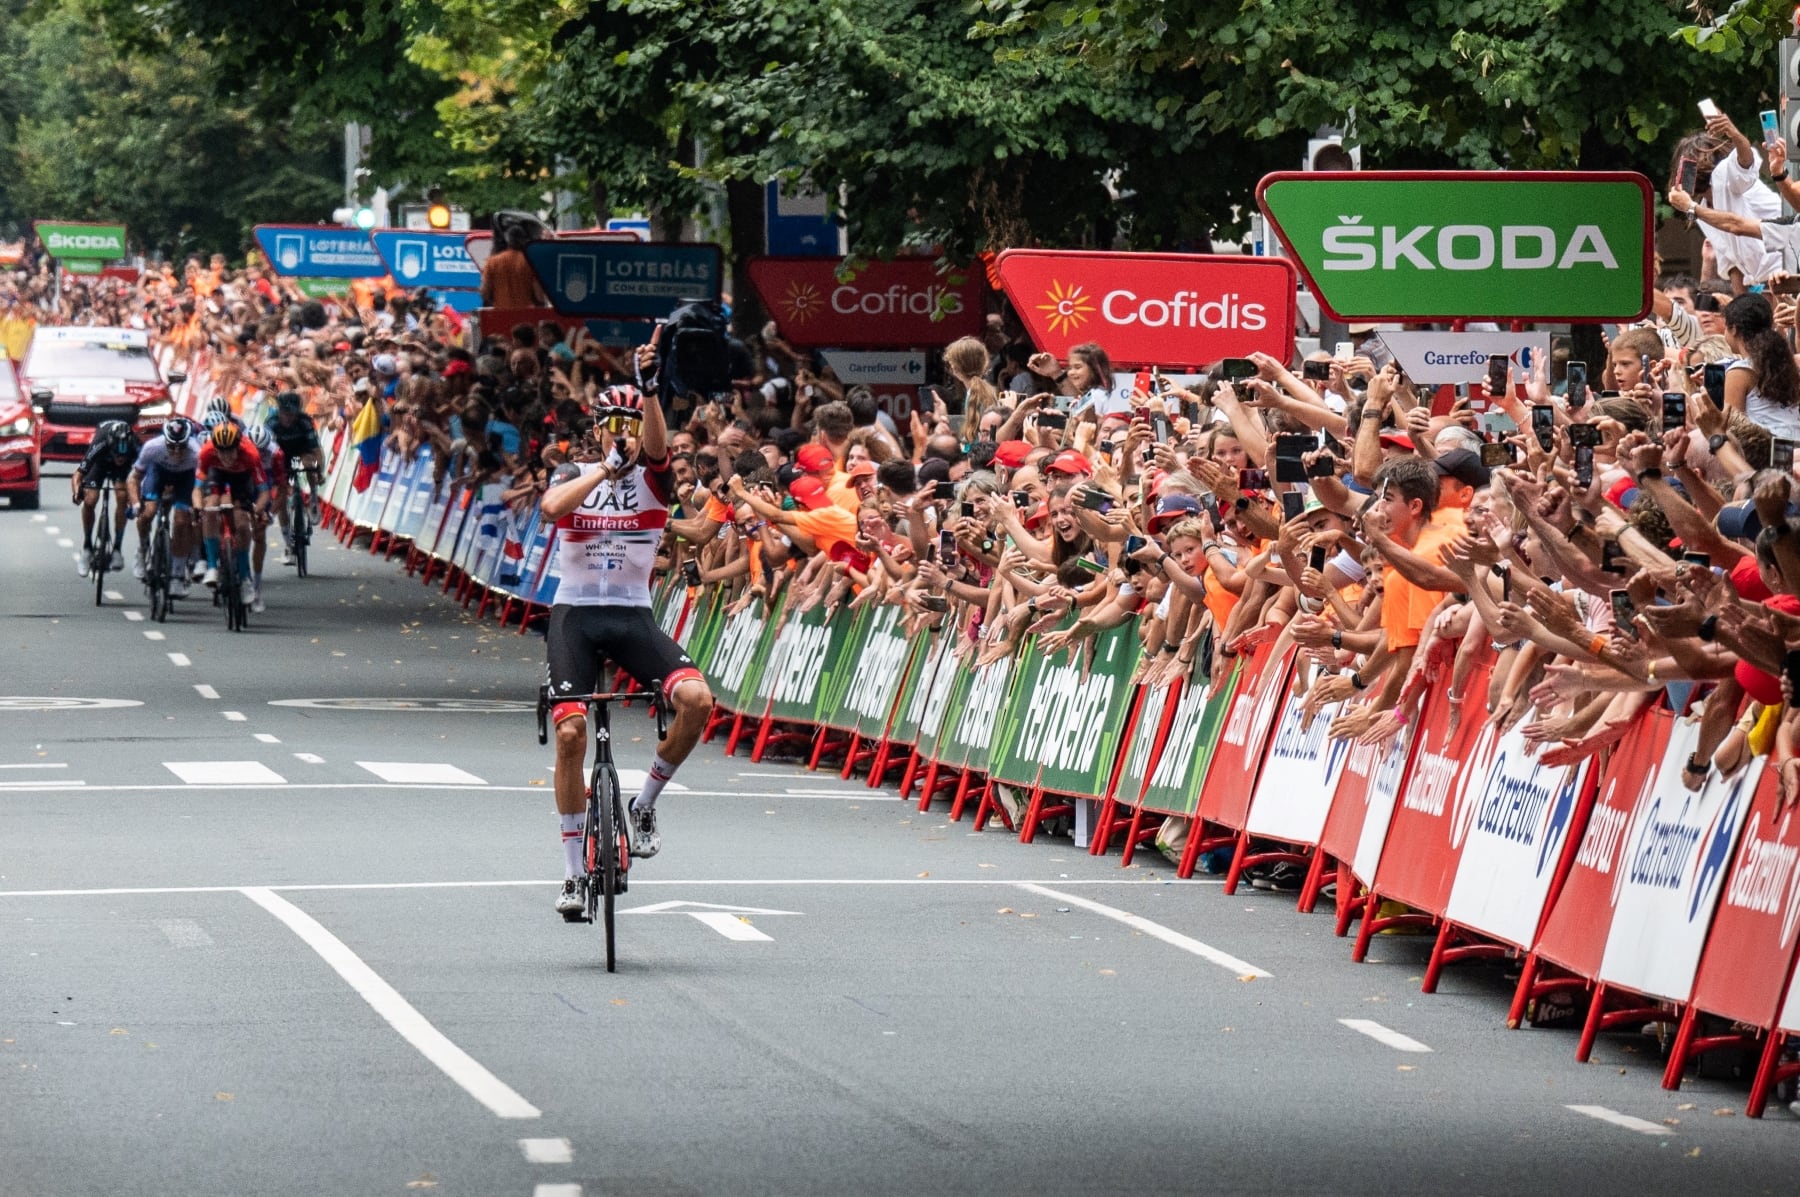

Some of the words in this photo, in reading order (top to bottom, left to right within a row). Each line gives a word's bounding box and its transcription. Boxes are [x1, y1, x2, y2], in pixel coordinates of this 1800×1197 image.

[48, 233, 120, 249] ŠKODA
[309, 237, 374, 255] LOTERÍA
[1322, 216, 1619, 270] ŠKODA
[606, 259, 709, 280] LOTERÍAS
[1102, 289, 1267, 331] Cofidis
[849, 363, 897, 373] Carrefour
[581, 490, 639, 512] UAE
[573, 515, 640, 530] Emirates
[1477, 751, 1551, 846] Carrefour
[1631, 795, 1701, 890] Carrefour
[1728, 811, 1799, 915] Carrefour
